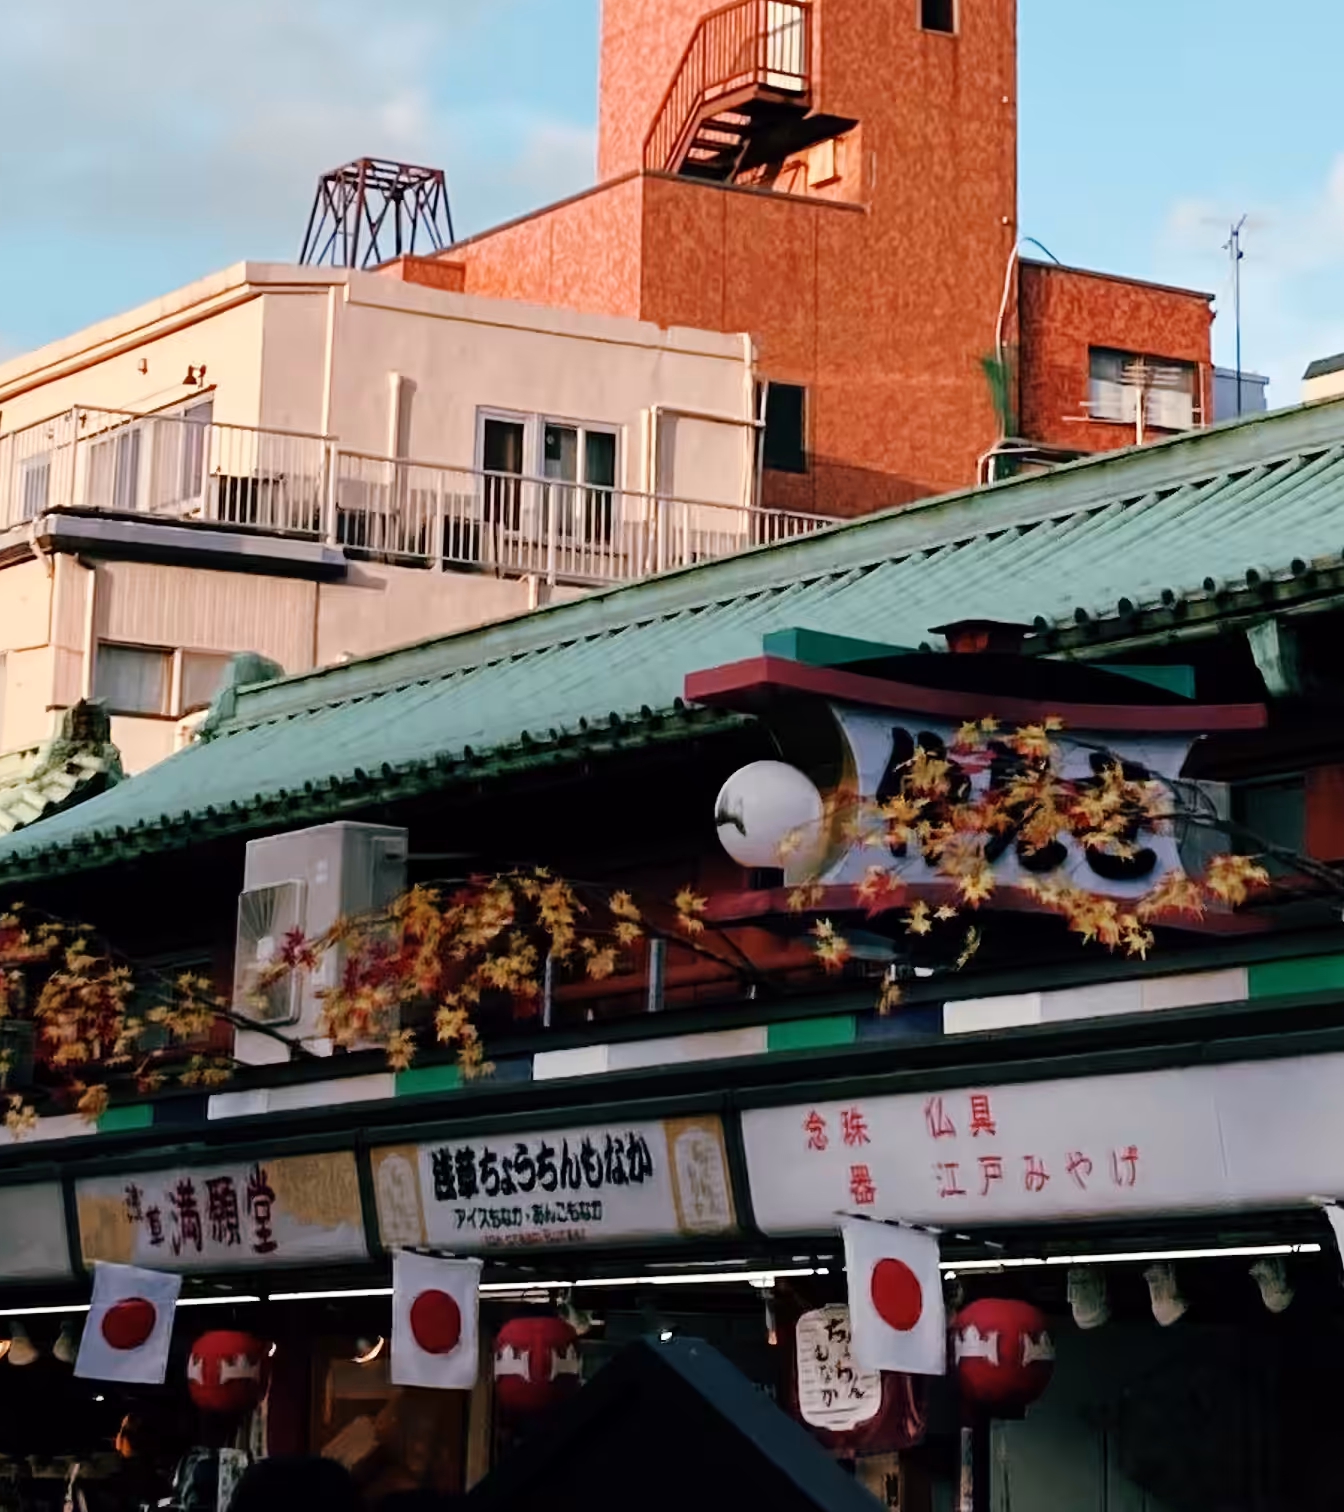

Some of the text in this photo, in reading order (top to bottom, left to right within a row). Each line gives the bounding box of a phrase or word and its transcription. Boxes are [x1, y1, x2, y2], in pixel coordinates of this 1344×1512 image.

[924, 1094, 997, 1139] 仏具
[935, 1144, 1140, 1199] 江戸みやげ
